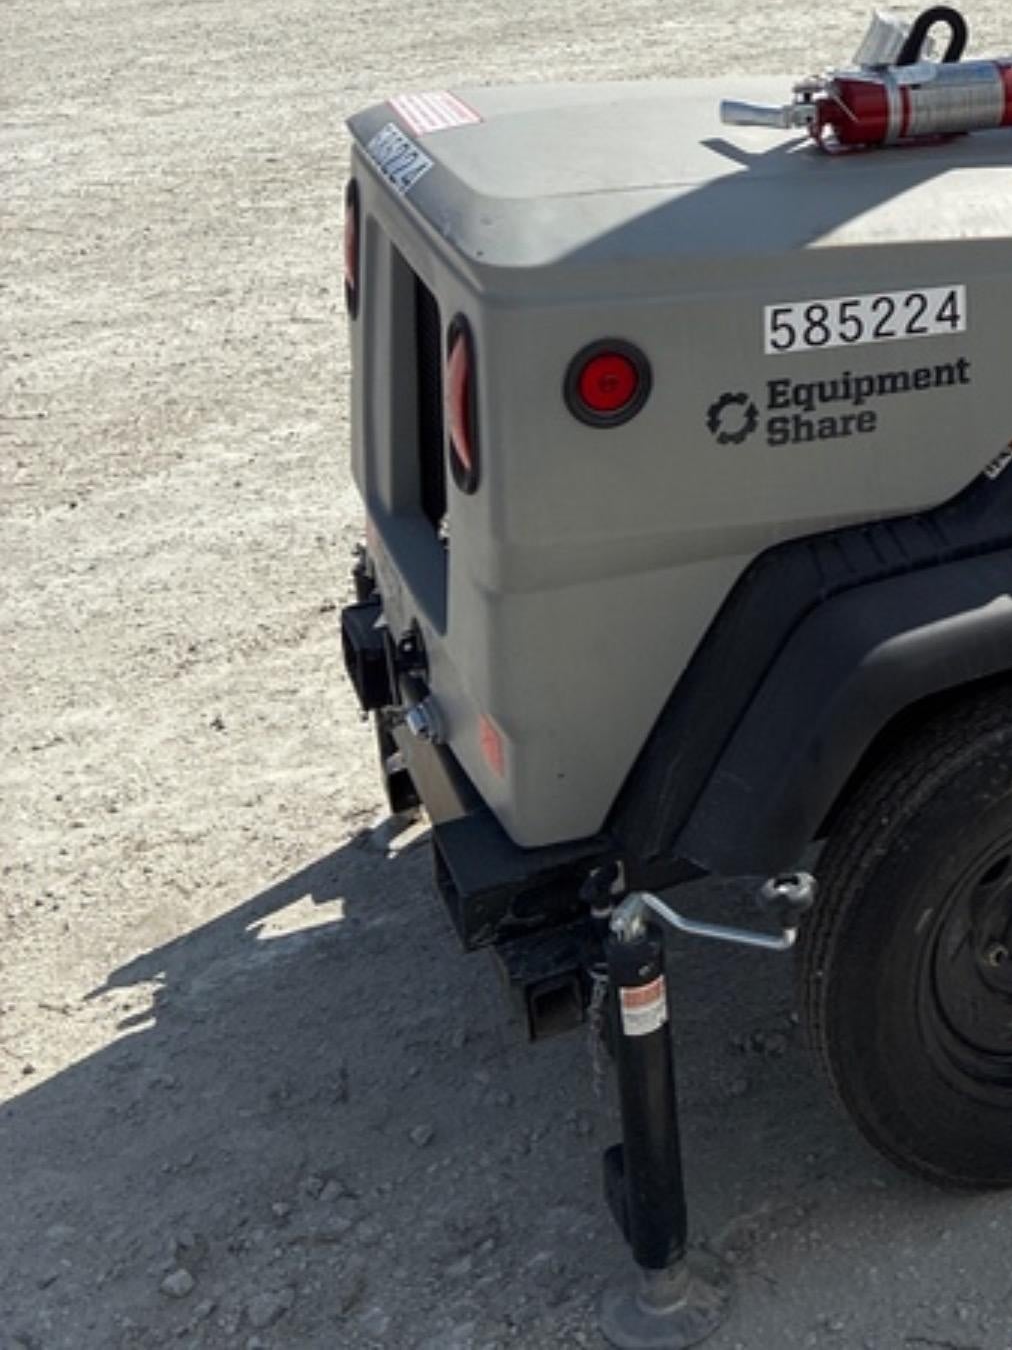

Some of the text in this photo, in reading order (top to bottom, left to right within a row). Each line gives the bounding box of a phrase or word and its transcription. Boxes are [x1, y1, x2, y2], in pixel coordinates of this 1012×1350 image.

[769, 290, 961, 351] 585224
[767, 358, 971, 411] Equipment
[767, 410, 877, 446] Share
